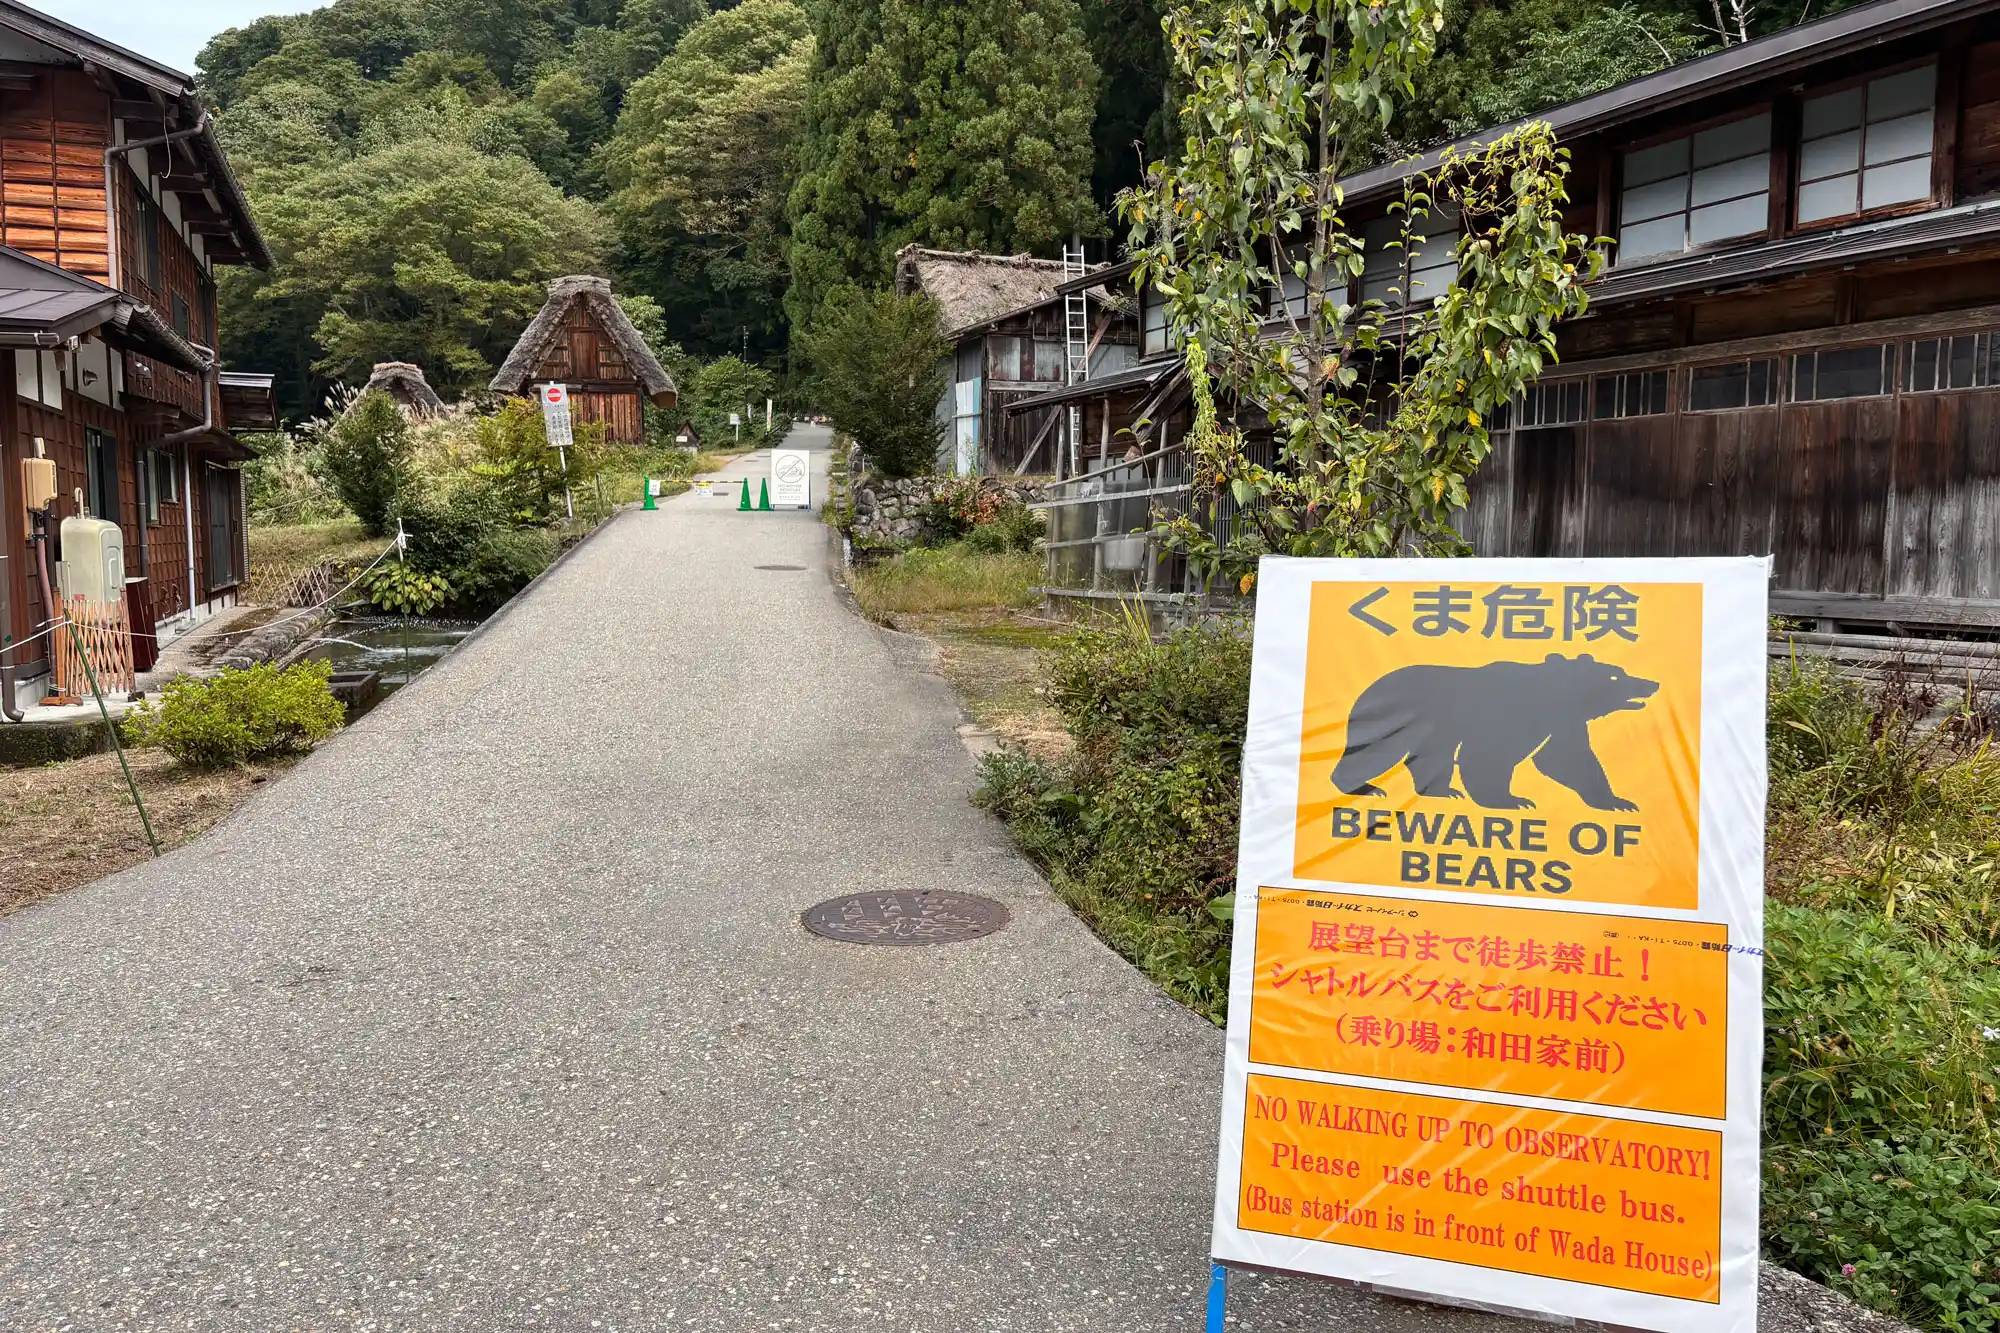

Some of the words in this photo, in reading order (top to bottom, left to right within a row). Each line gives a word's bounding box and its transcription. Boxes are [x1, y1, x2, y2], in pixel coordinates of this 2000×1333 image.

[1347, 584, 1640, 642] くま危険
[1331, 806, 1548, 852] BEWARE
[1568, 822, 1642, 858] OF
[1400, 850, 1573, 894] BEARS
[1308, 920, 1649, 981] 展望台まで徒歩禁止！
[1271, 961, 1707, 1031] シャトルバスをご利用ください
[1254, 1094, 1288, 1123] NO
[1296, 1099, 1408, 1138] WALKING
[1417, 1115, 1450, 1143] UP
[1460, 1120, 1494, 1150] TO
[1505, 1126, 1711, 1181] OBSERVATORY!
[1270, 1142, 1361, 1179] Please
[1382, 1165, 1432, 1188] use
[1444, 1167, 1489, 1197] the
[1501, 1175, 1607, 1214] shuttle
[1619, 1190, 1685, 1225] bus.
[1246, 1184, 1293, 1216] (Bus
[1300, 1196, 1378, 1229] station
[1386, 1205, 1405, 1233] is
[1414, 1209, 1436, 1237] in
[1443, 1213, 1506, 1248] front
[1514, 1226, 1541, 1254] of
[1549, 1229, 1616, 1266] Wada
[1623, 1240, 1713, 1283] House)
